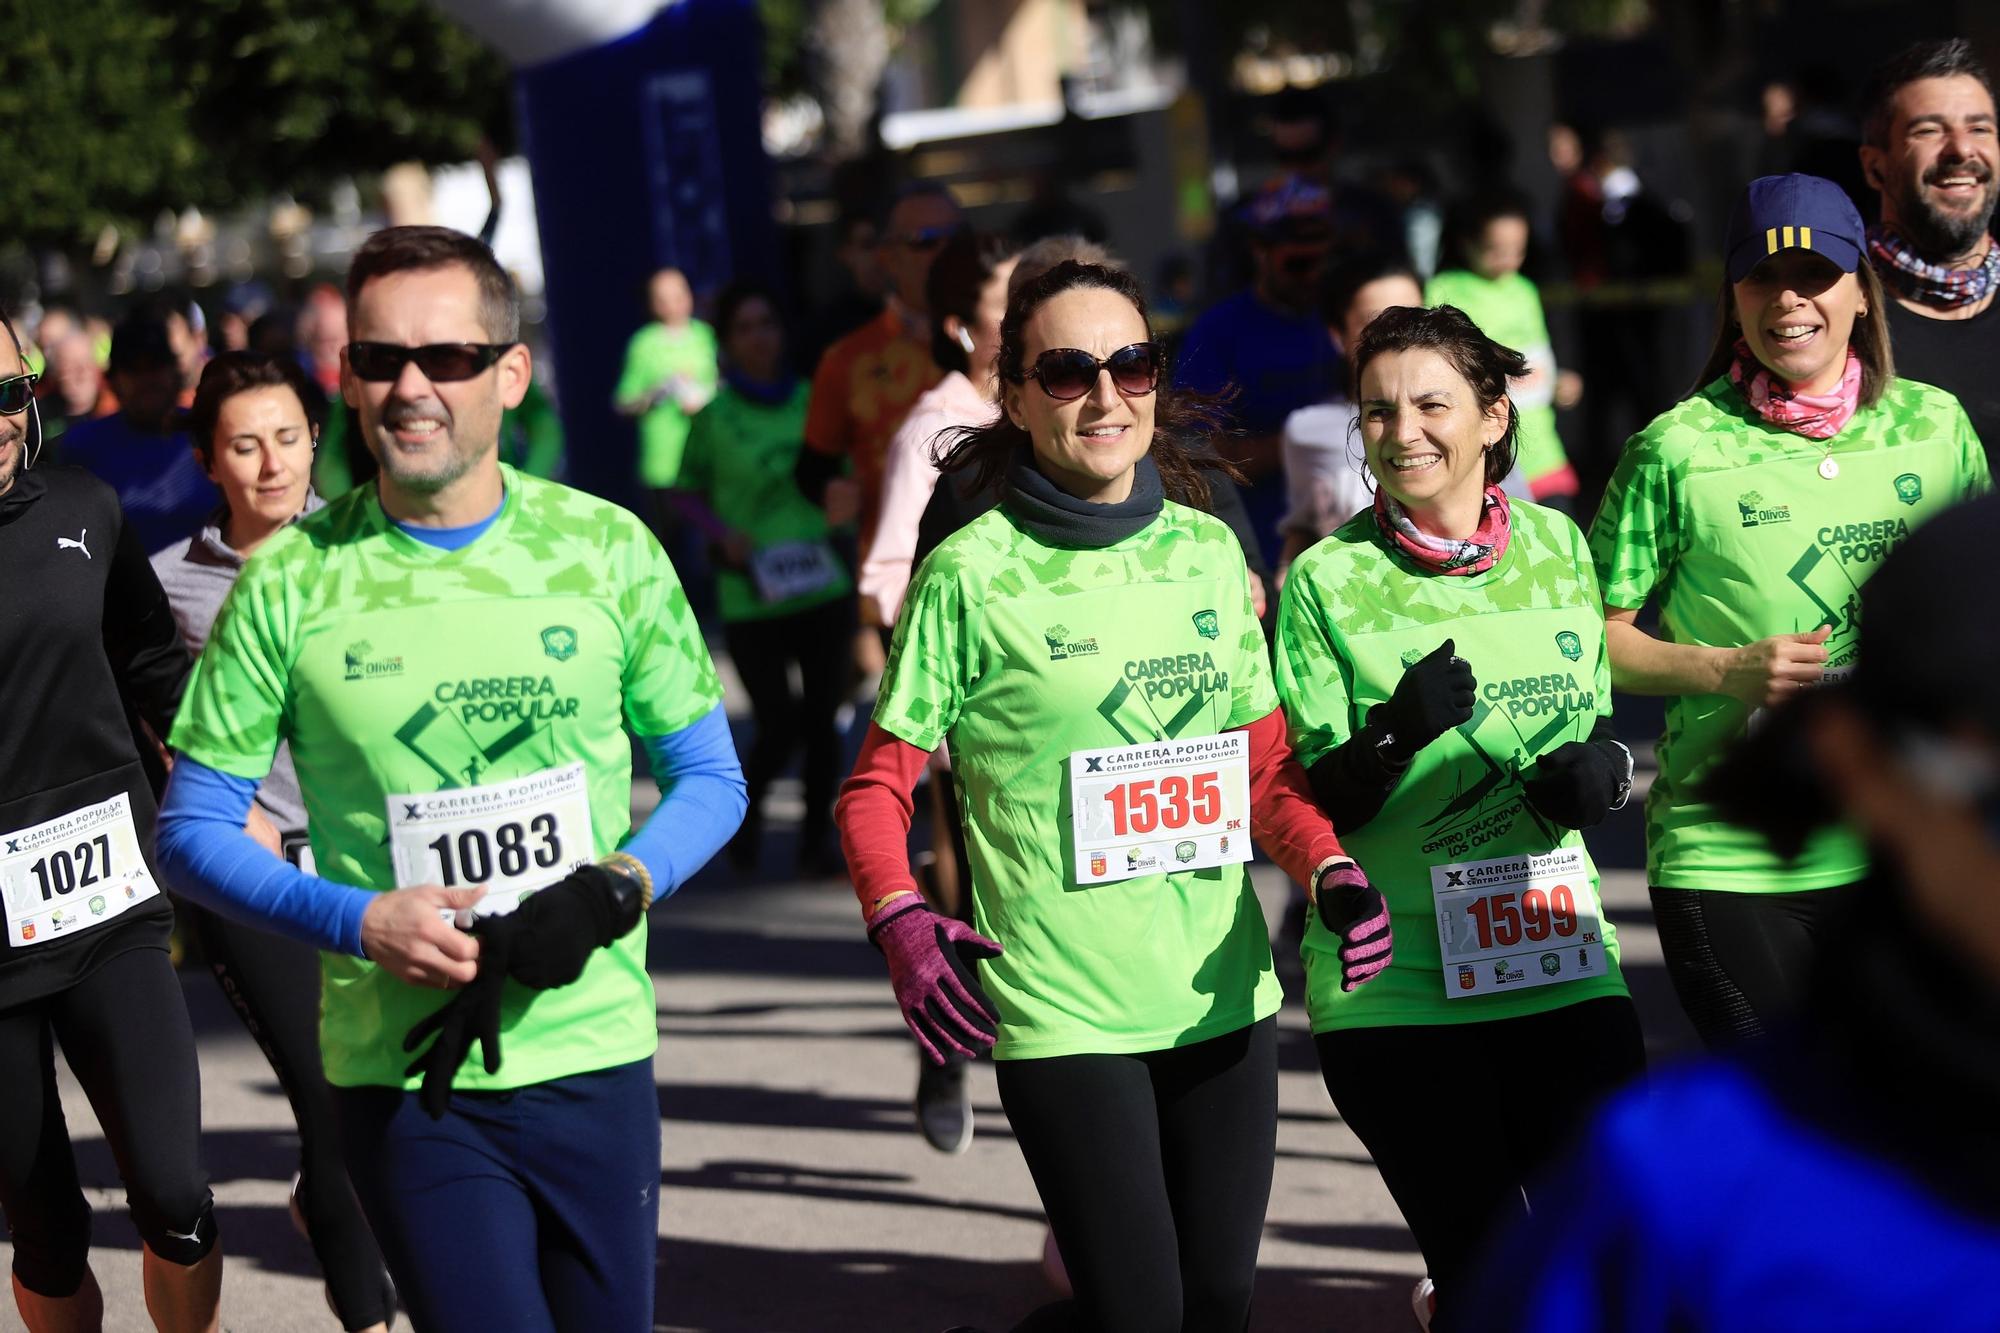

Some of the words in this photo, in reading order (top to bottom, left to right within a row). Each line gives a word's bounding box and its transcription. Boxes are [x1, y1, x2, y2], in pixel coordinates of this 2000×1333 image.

[1759, 510, 1790, 521] Olivos
[1817, 518, 1911, 547] CARRERA
[1840, 539, 1898, 565] POPU
[1067, 642, 1099, 654] Olivos
[366, 662, 404, 674] Olivos
[1125, 652, 1215, 681] CARRERA
[435, 675, 556, 703] CARRERA
[1144, 672, 1228, 701] POPULAR
[1483, 673, 1579, 702] CARRERA
[461, 697, 580, 725] POPULAR
[1507, 692, 1594, 720] POPULAR
[1085, 757, 1103, 773] X
[1107, 748, 1171, 764] CARRERA
[1177, 739, 1239, 756] POPULAR
[1107, 762, 1140, 772] CENTRO
[1143, 756, 1191, 768] EDUCATIVO
[1211, 749, 1240, 759] OLIVOS
[404, 803, 423, 820] X
[427, 792, 502, 810] CARRERA
[1104, 771, 1221, 836] 1535
[5, 838, 20, 854] X
[23, 821, 73, 843] CARRERA
[76, 801, 122, 824] POPULAR
[1227, 819, 1241, 830] 5K
[1422, 832, 1463, 853] CENTRO
[1466, 803, 1522, 838] EDUCATIVO
[1448, 841, 1469, 858] LOS
[1471, 820, 1513, 848] OLIVOS
[429, 813, 563, 887] 1083
[30, 833, 111, 902] 1027
[1445, 870, 1464, 887] X
[1467, 862, 1529, 878] CARRERA
[1533, 853, 1578, 868] POPULAR
[1467, 876, 1500, 886] CENTRO
[1503, 869, 1546, 881] EDUCATIVO
[1467, 885, 1577, 949] 1599
[1583, 932, 1596, 943] 5K
